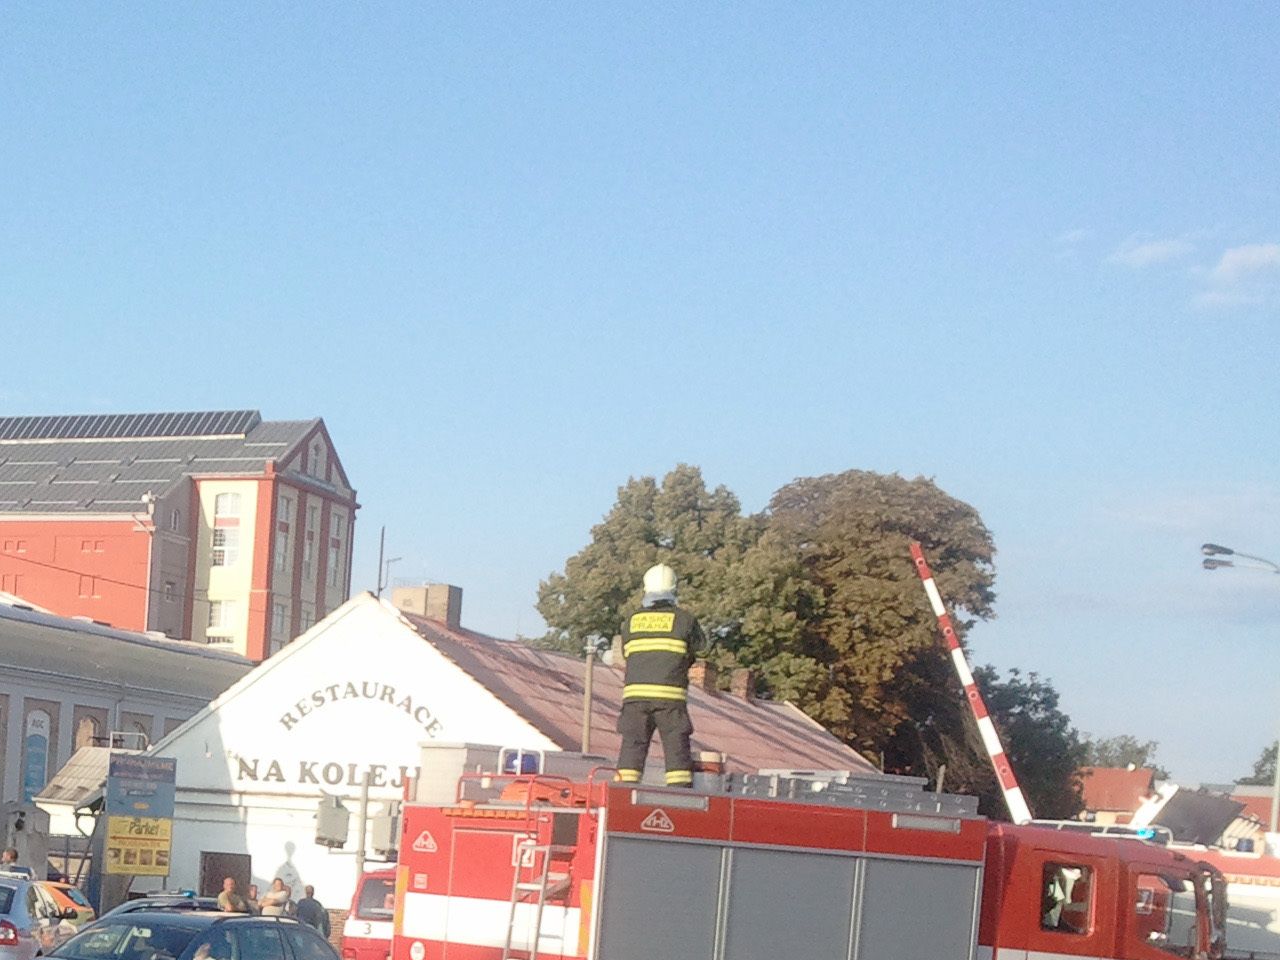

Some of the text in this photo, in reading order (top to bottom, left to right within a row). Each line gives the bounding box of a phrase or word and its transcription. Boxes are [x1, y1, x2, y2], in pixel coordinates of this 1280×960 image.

[279, 681, 445, 739] RESTAURACE
[237, 757, 286, 782] NA
[363, 922, 372, 935] 3
